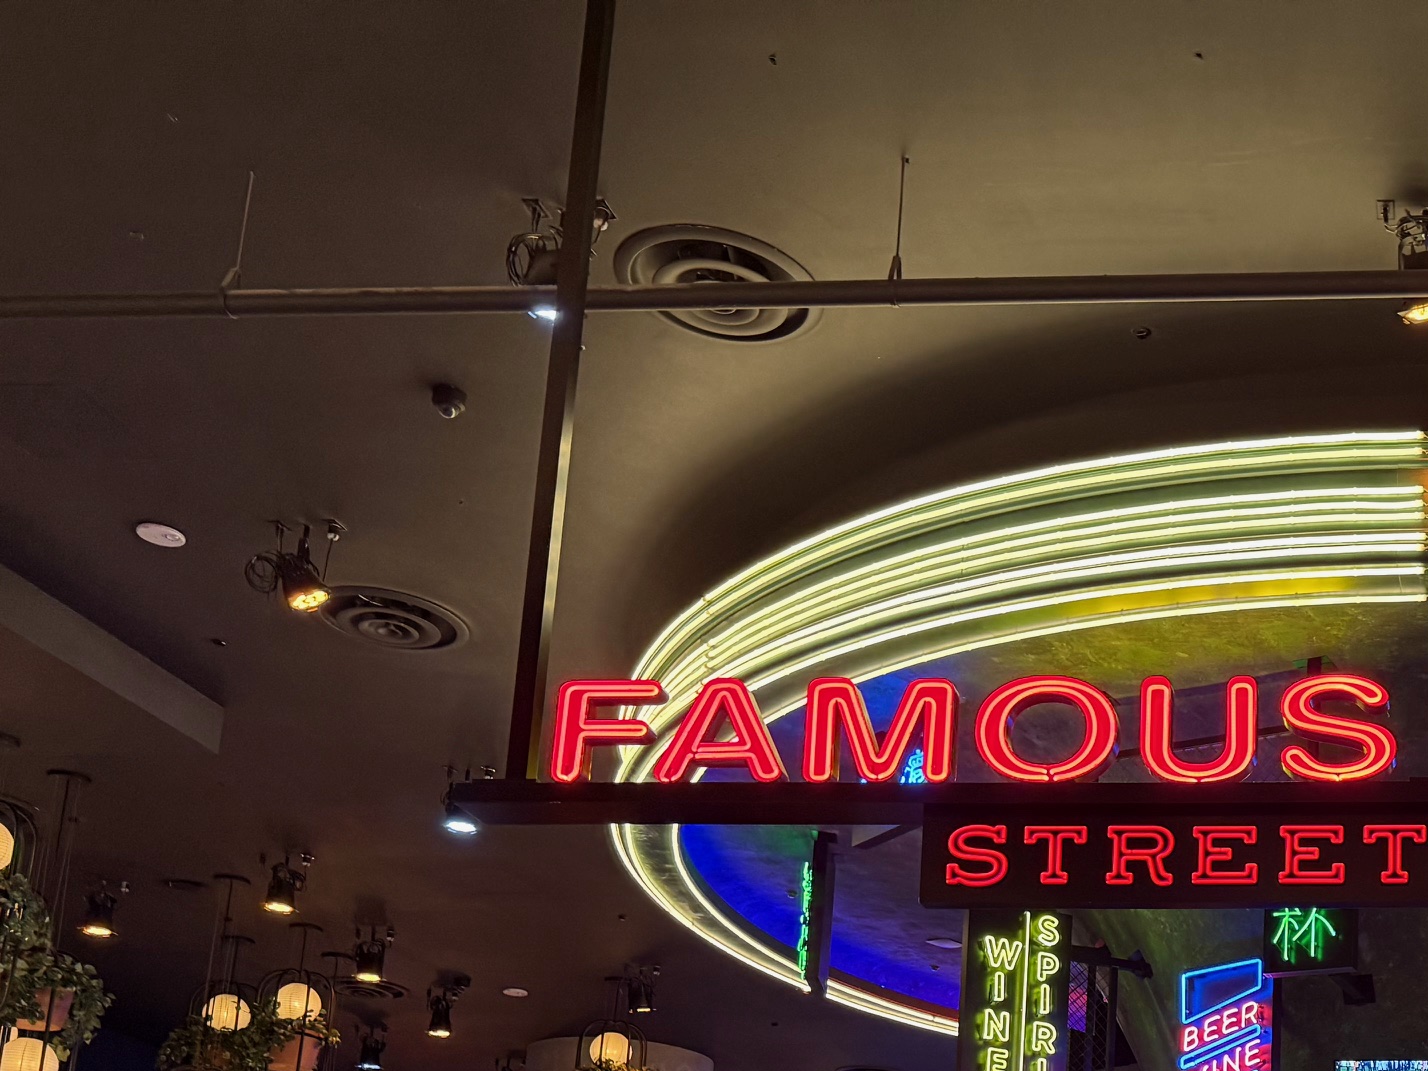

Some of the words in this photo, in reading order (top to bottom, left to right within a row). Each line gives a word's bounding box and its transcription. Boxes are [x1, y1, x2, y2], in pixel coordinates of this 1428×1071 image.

[549, 674, 1399, 783] FAMOUS
[944, 823, 1428, 888] STREET
[1183, 1001, 1259, 1051] BEER
